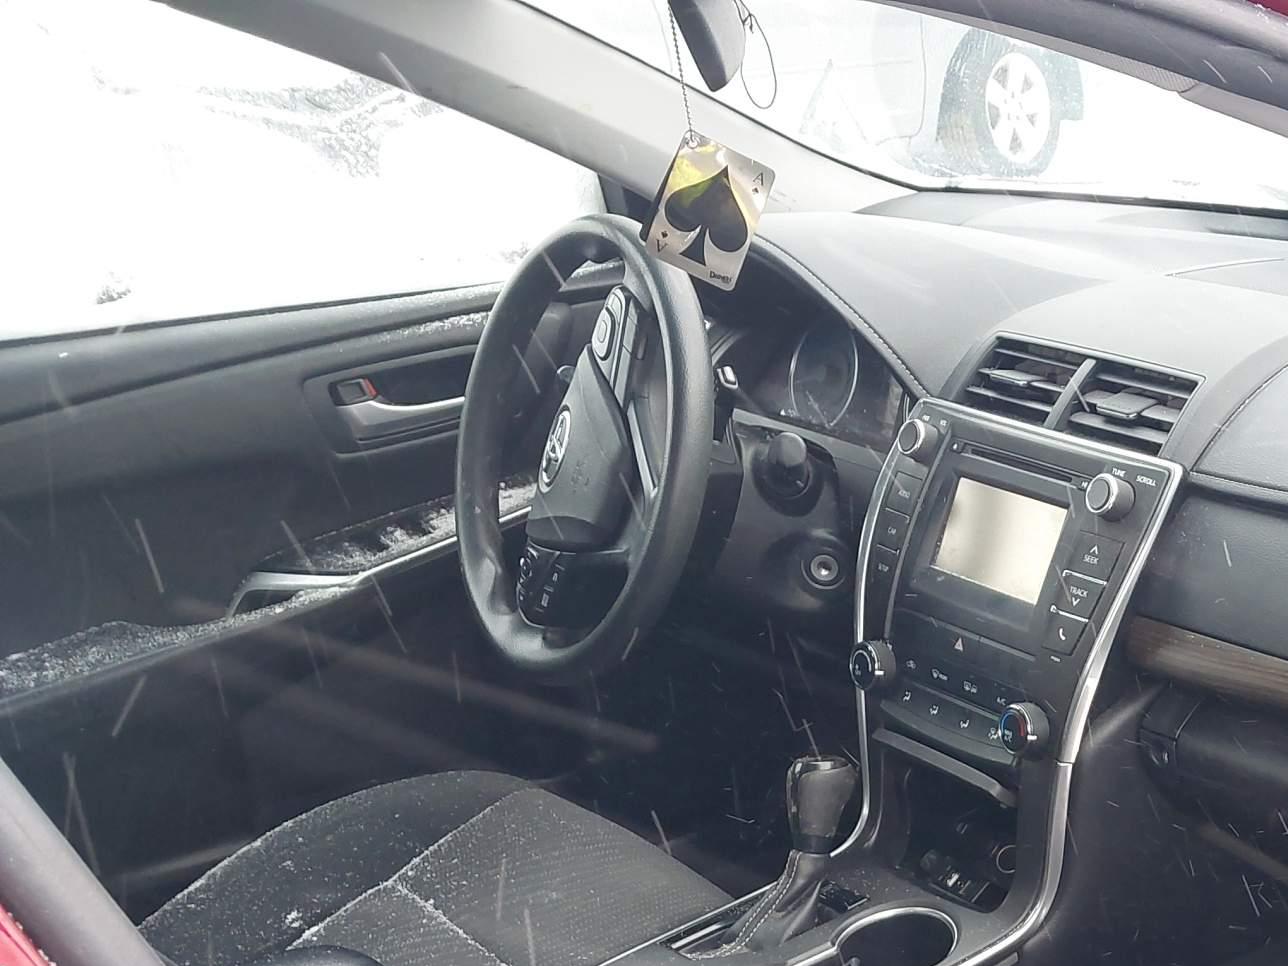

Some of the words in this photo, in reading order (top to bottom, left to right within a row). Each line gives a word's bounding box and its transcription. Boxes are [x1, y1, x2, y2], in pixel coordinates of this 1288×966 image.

[1111, 467, 1127, 479] TUNE
[1135, 474, 1157, 487] SCROLL
[1083, 553, 1100, 565] SEEK
[1070, 585, 1089, 598] TRACK
